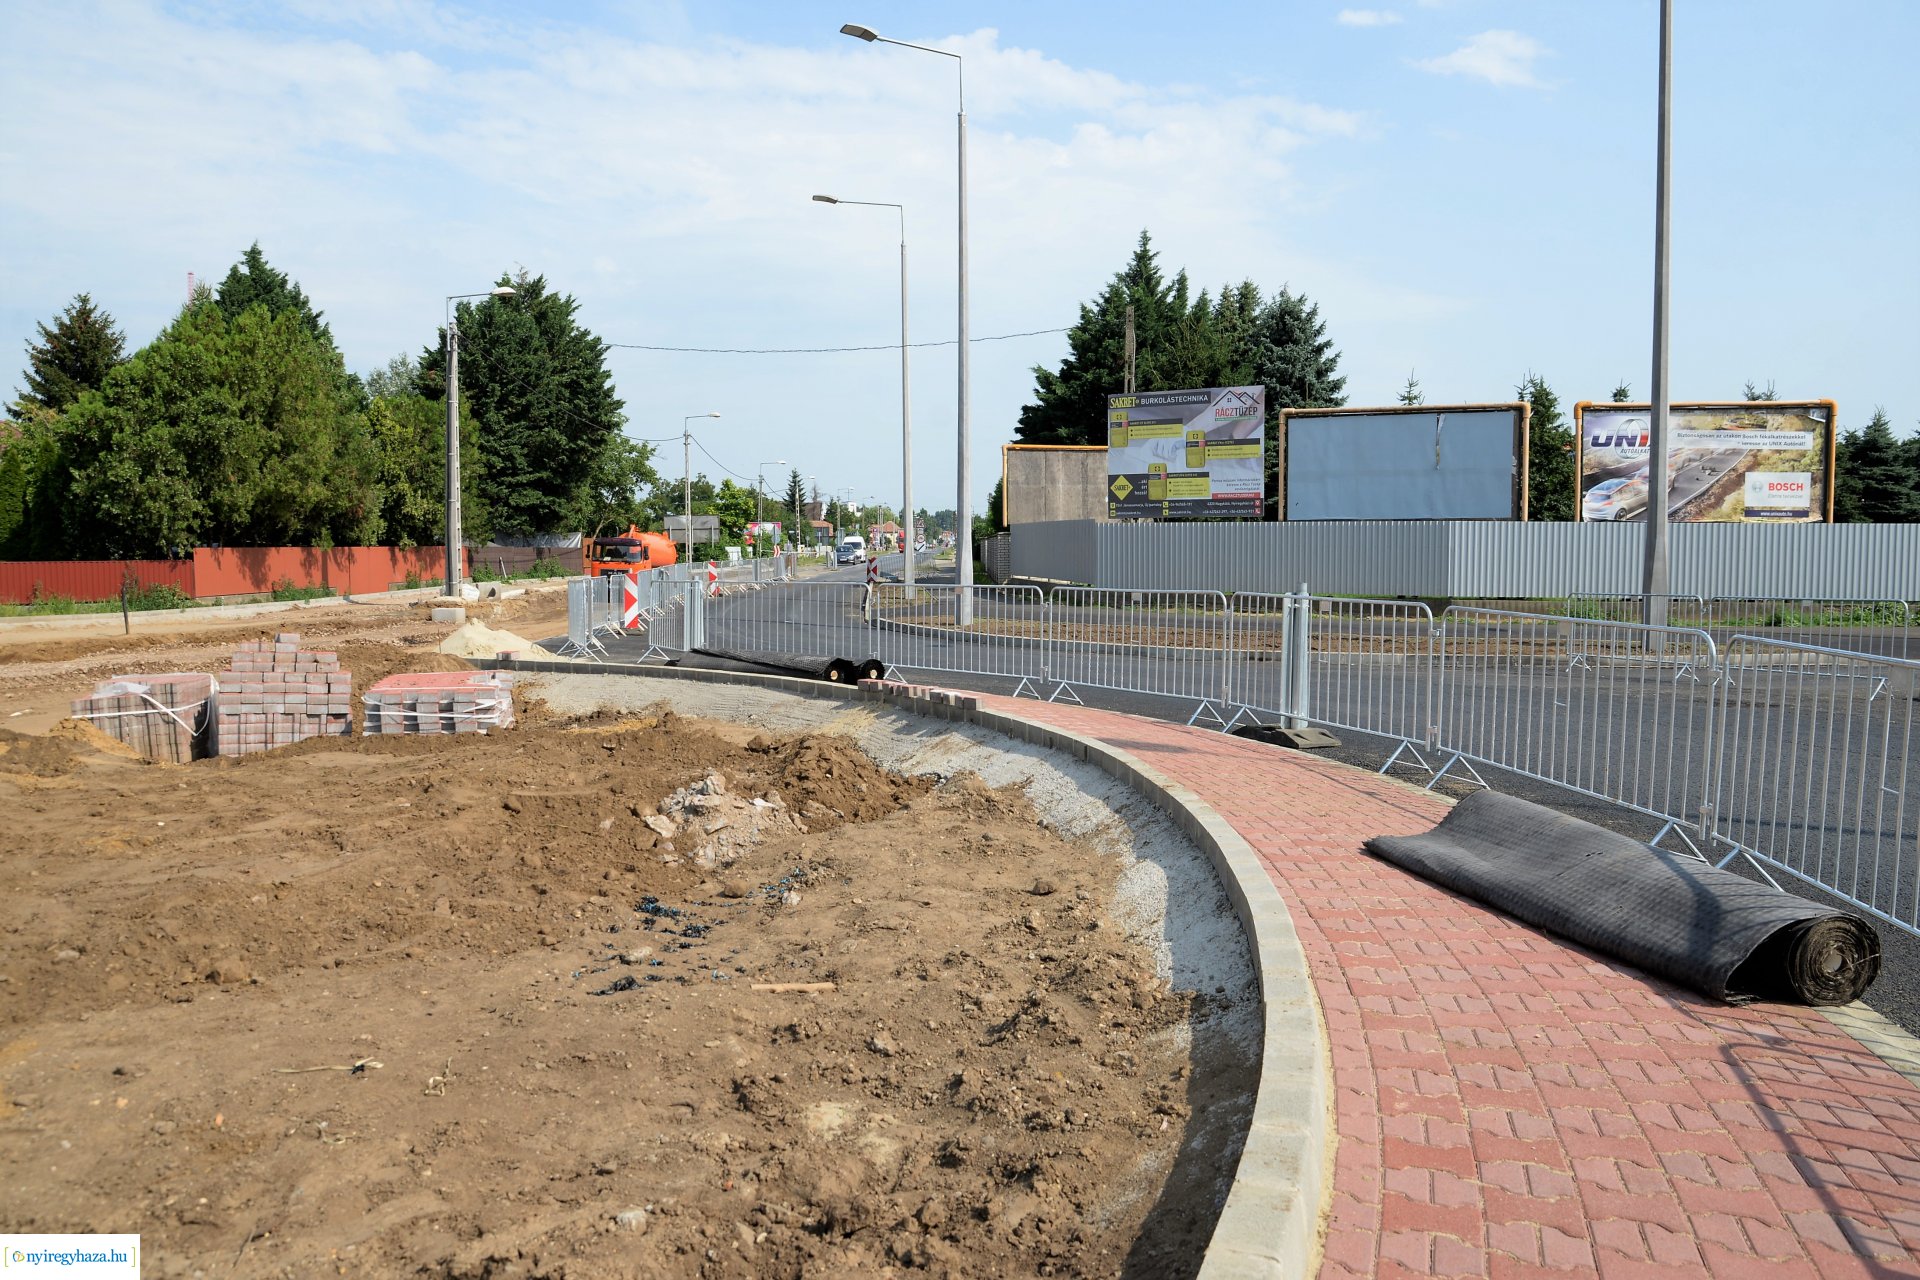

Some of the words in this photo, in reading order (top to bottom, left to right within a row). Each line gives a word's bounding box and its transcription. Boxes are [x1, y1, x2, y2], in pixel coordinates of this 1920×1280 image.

[1110, 397, 1136, 408] SAKRET
[1141, 394, 1208, 405] BURKOLÁSTECHNIKA
[1591, 429, 1651, 447] UNI
[1768, 482, 1804, 492] BOSCH
